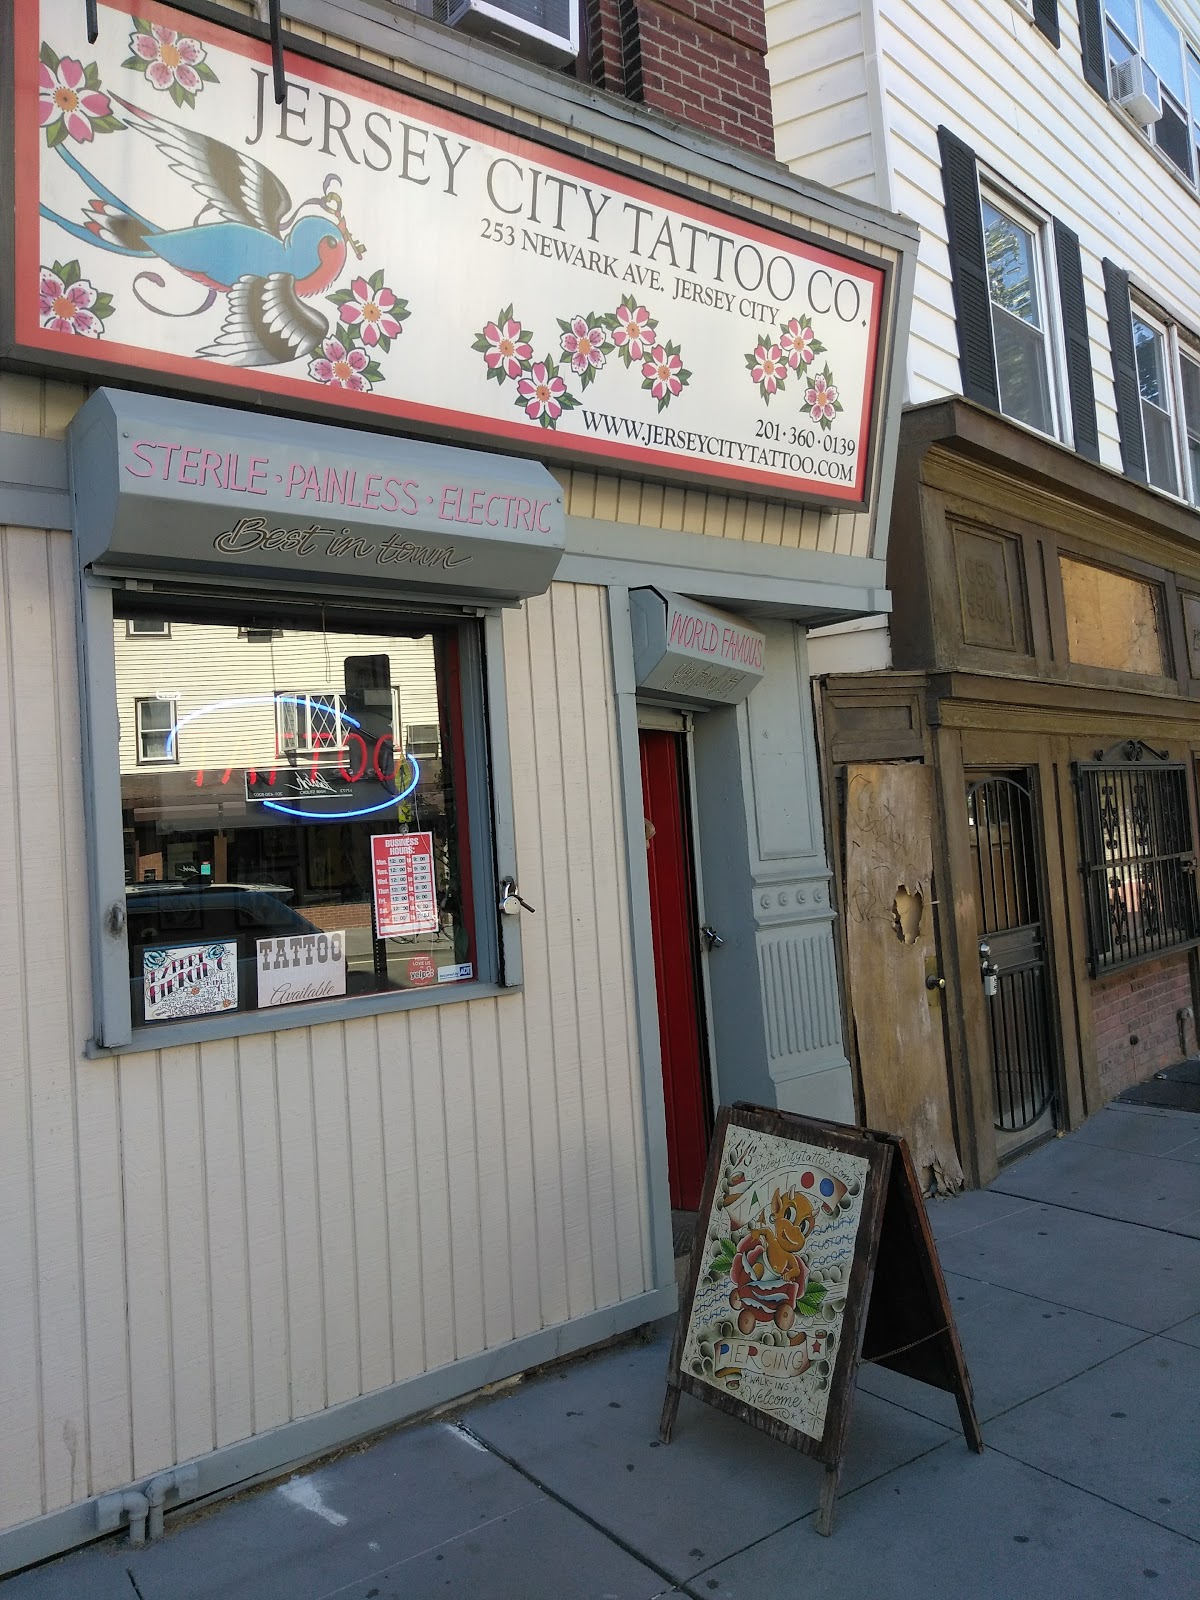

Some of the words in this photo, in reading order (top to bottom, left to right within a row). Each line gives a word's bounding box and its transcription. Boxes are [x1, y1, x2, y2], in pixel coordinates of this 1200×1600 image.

[245, 67, 471, 197] JERSEY
[486, 157, 611, 244] CITY
[622, 202, 796, 302] TATTOO
[807, 268, 869, 329] CO.
[480, 217, 515, 247] 253
[521, 228, 619, 280] NEWARK
[622, 261, 665, 293] AVE.
[672, 276, 737, 315] JERSEY
[739, 298, 780, 326] CITY
[582, 409, 854, 484] WWW.JERSEYCITYTATTOO.COM
[124, 440, 270, 496] STERILE
[284, 462, 420, 516] PAINLESS
[438, 485, 553, 536] ELECTRIC
[212, 516, 335, 555] Best
[327, 528, 374, 561] in
[376, 532, 473, 571] town
[670, 611, 719, 656] WORLD
[720, 627, 763, 669] FAMOUS
[193, 732, 402, 788] TTOO
[385, 838, 420, 848] BUSINESS
[389, 847, 415, 856] HOURS:
[259, 933, 342, 971] TATTOO
[270, 980, 335, 1005] Available
[718, 1343, 804, 1371] PIERCING
[744, 1385, 802, 1408] Welcome
